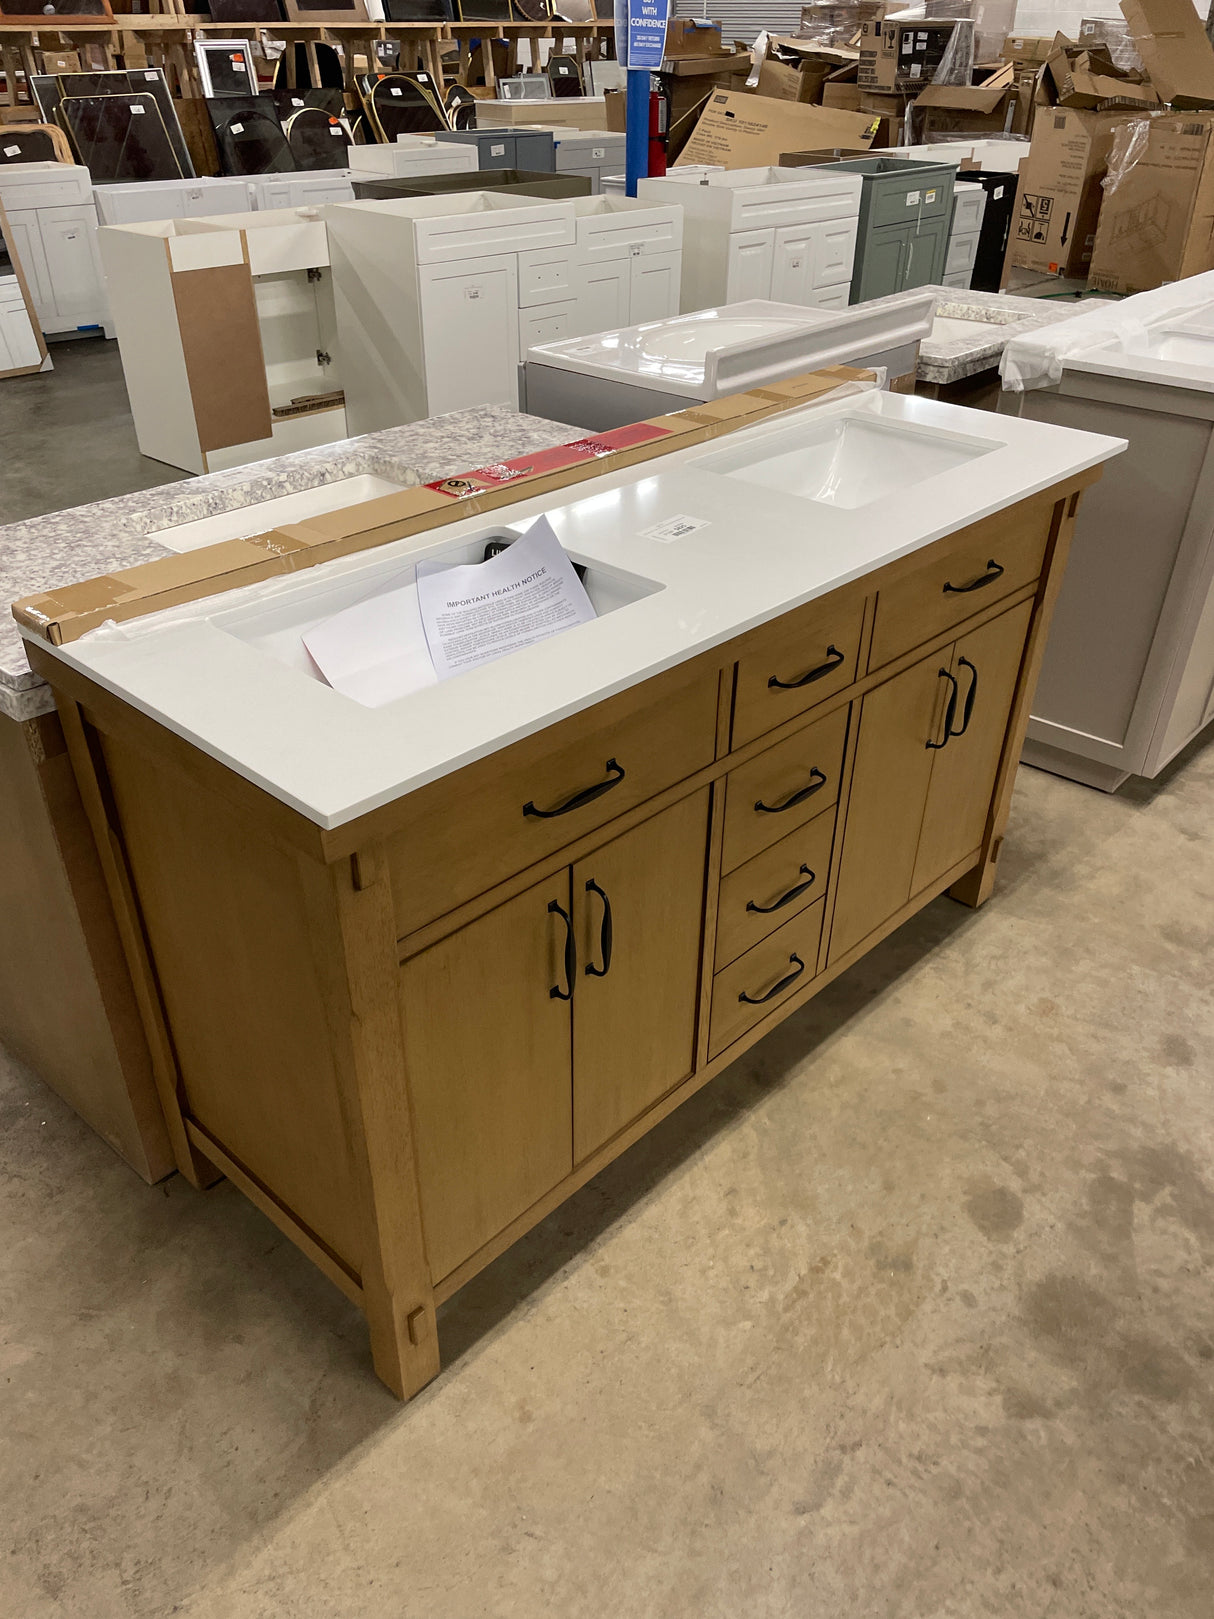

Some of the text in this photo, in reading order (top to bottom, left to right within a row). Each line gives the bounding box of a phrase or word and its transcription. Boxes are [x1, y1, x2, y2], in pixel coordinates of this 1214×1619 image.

[642, 6, 657, 15] WITH
[631, 18, 666, 28] CONFIDENCE
[1091, 276, 1119, 289] HOME
[446, 566, 547, 608] IMPORTANT HEALTH NOTICE
